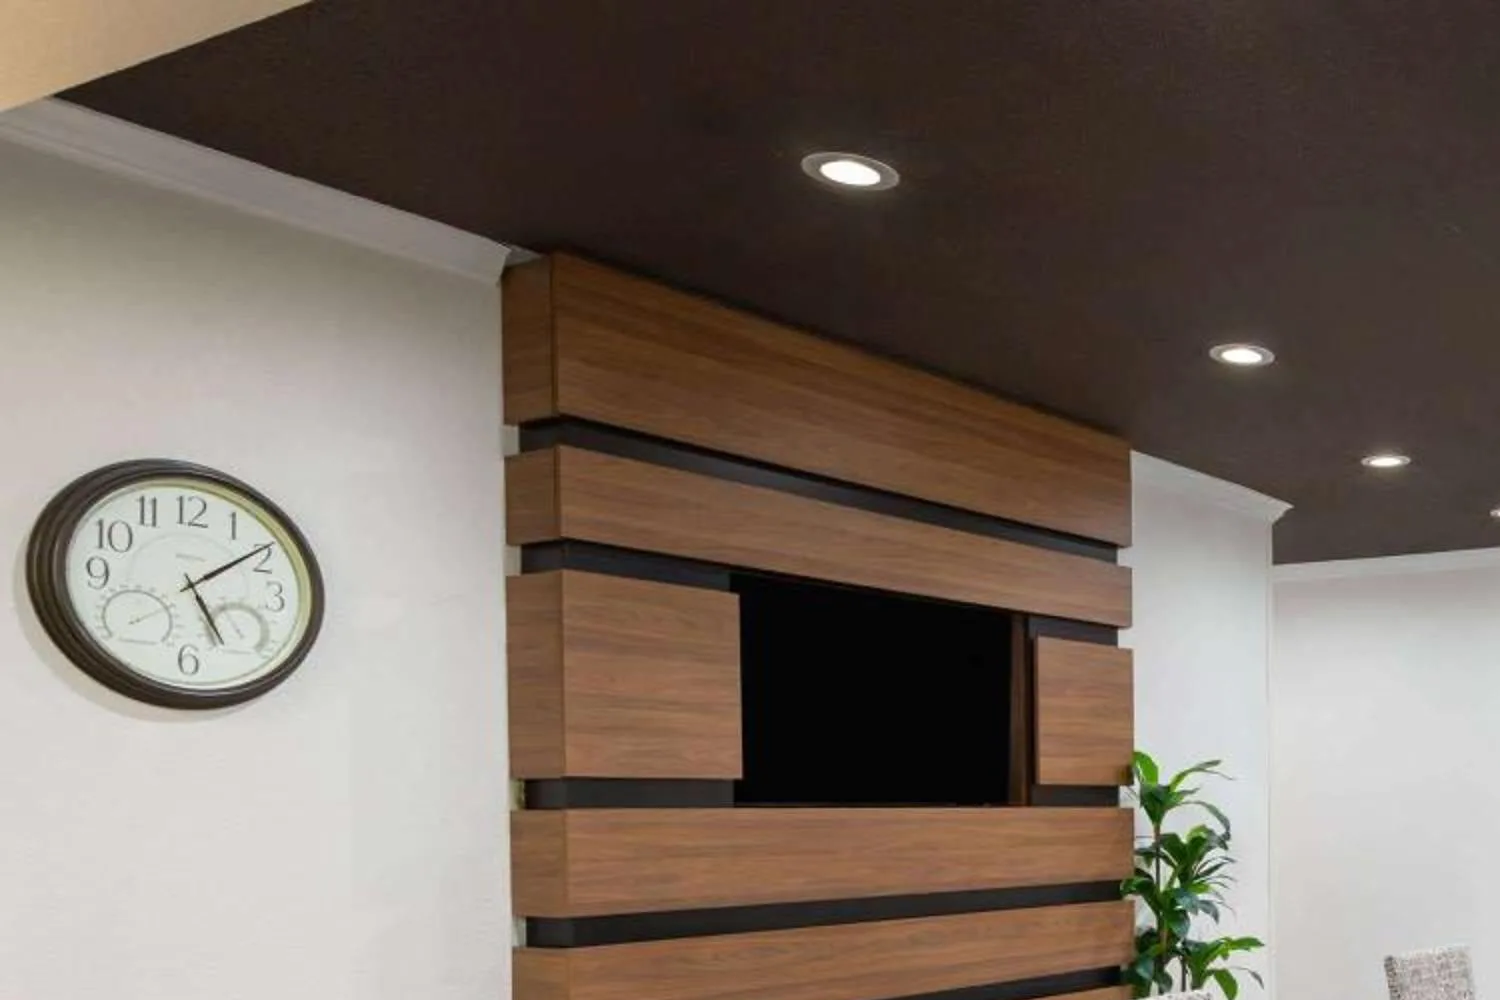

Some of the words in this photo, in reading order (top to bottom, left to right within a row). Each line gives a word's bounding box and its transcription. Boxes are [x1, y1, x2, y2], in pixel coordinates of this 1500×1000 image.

[136, 495, 159, 528] 11
[176, 495, 209, 528] 12
[229, 511, 238, 541] 1
[95, 517, 133, 553] 10
[85, 555, 110, 589] 9
[252, 543, 274, 575] 2
[264, 580, 285, 613] 3
[177, 643, 200, 676] 6
